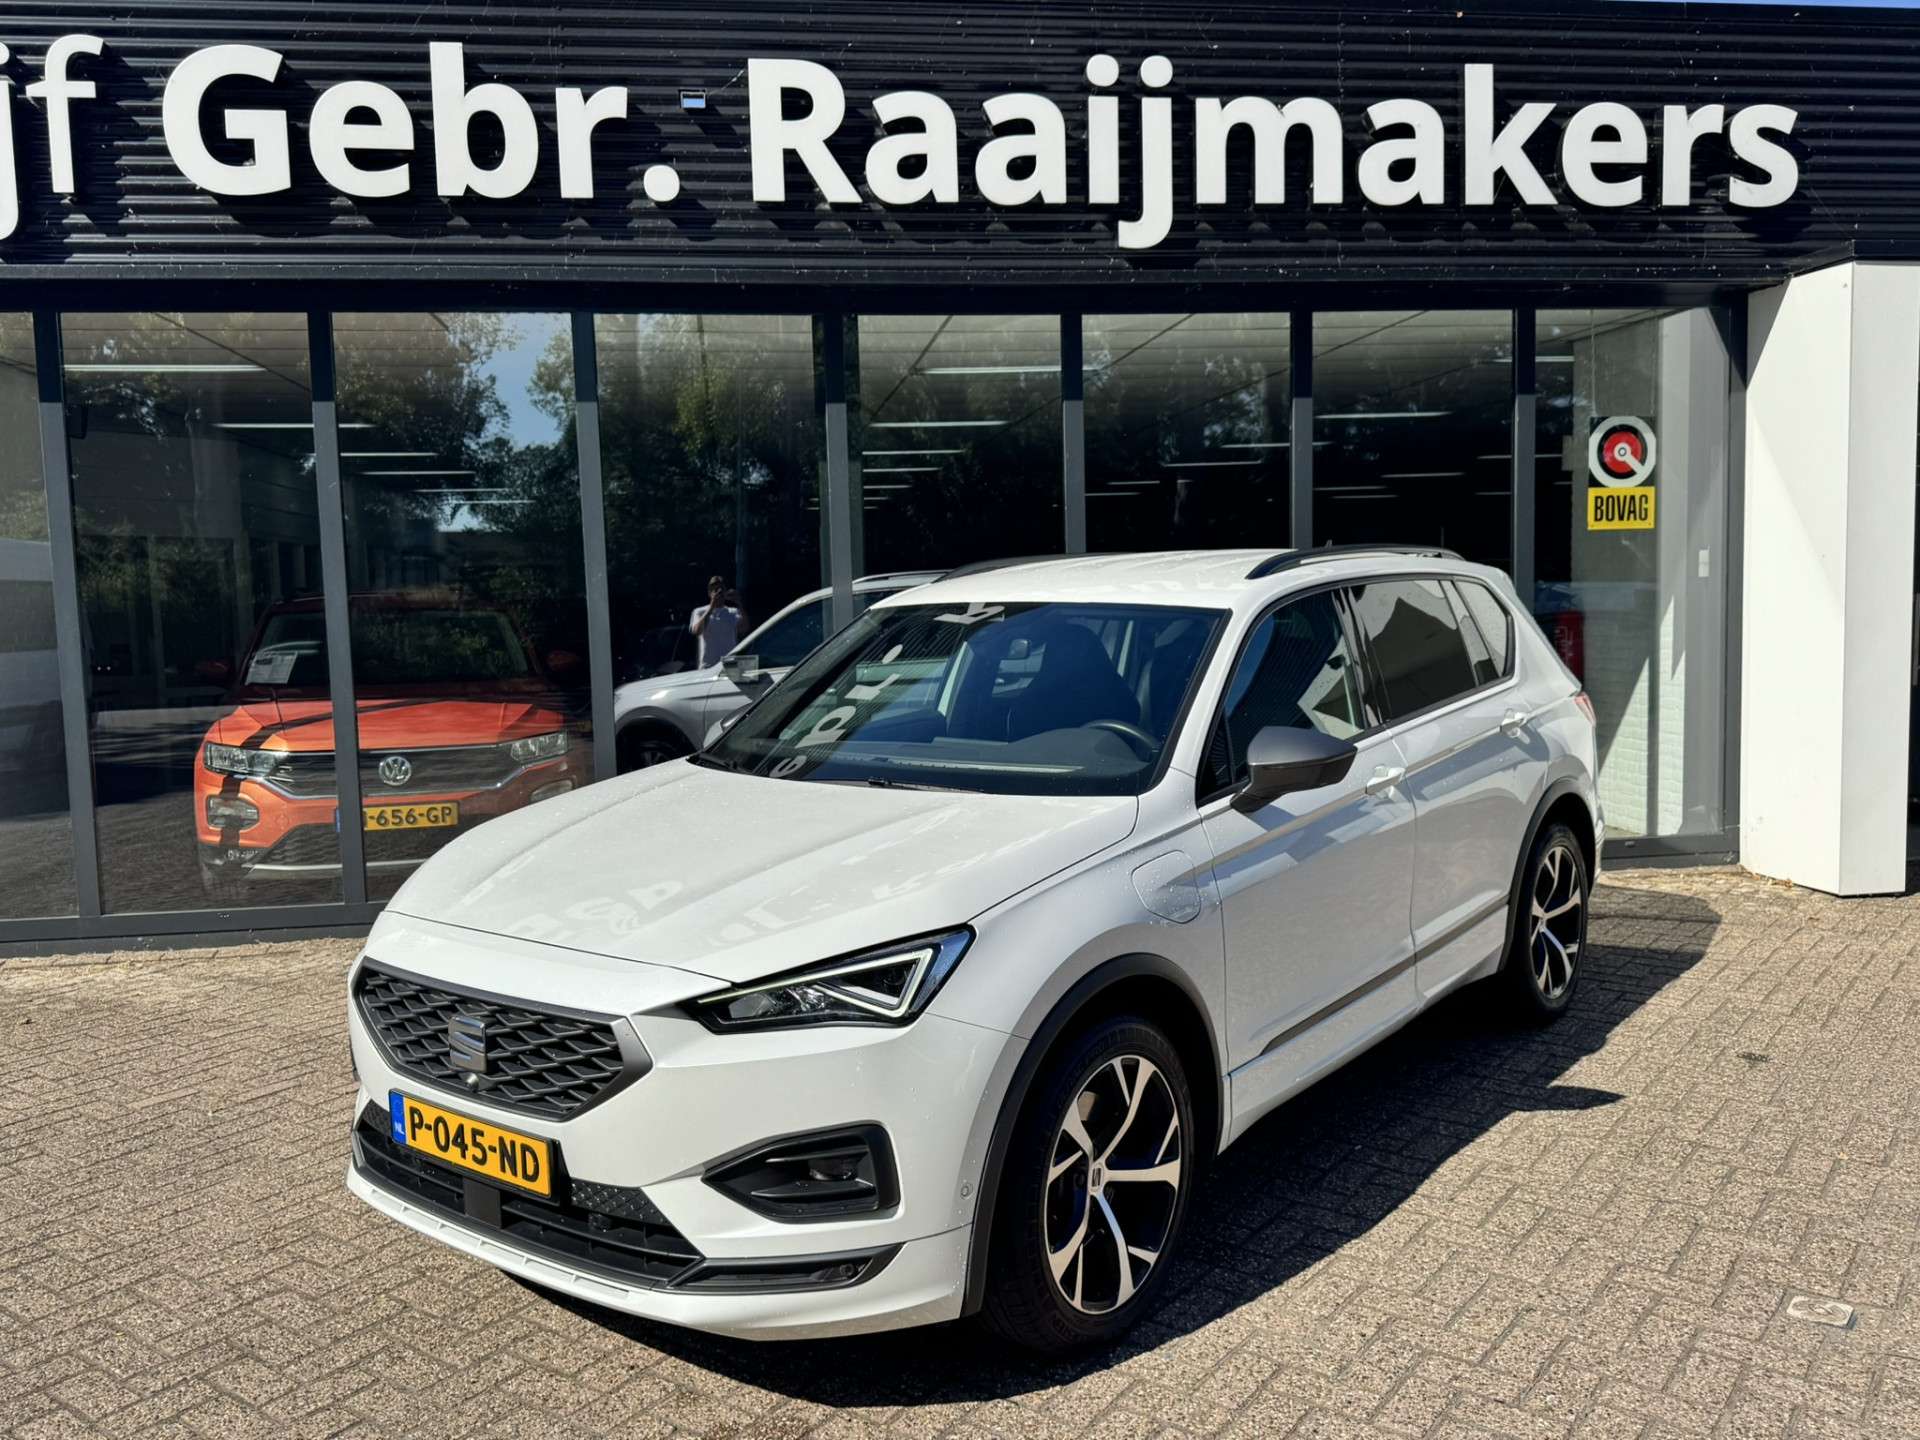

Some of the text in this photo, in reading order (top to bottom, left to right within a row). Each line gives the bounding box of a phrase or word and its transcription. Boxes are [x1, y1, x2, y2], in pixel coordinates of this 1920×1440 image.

[162, 42, 681, 203] Gebr.
[747, 54, 1799, 249] Raaijmakers
[1594, 494, 1649, 522] BOVAG
[363, 806, 453, 828] -656-GP
[409, 1106, 540, 1183] P-045-ND
